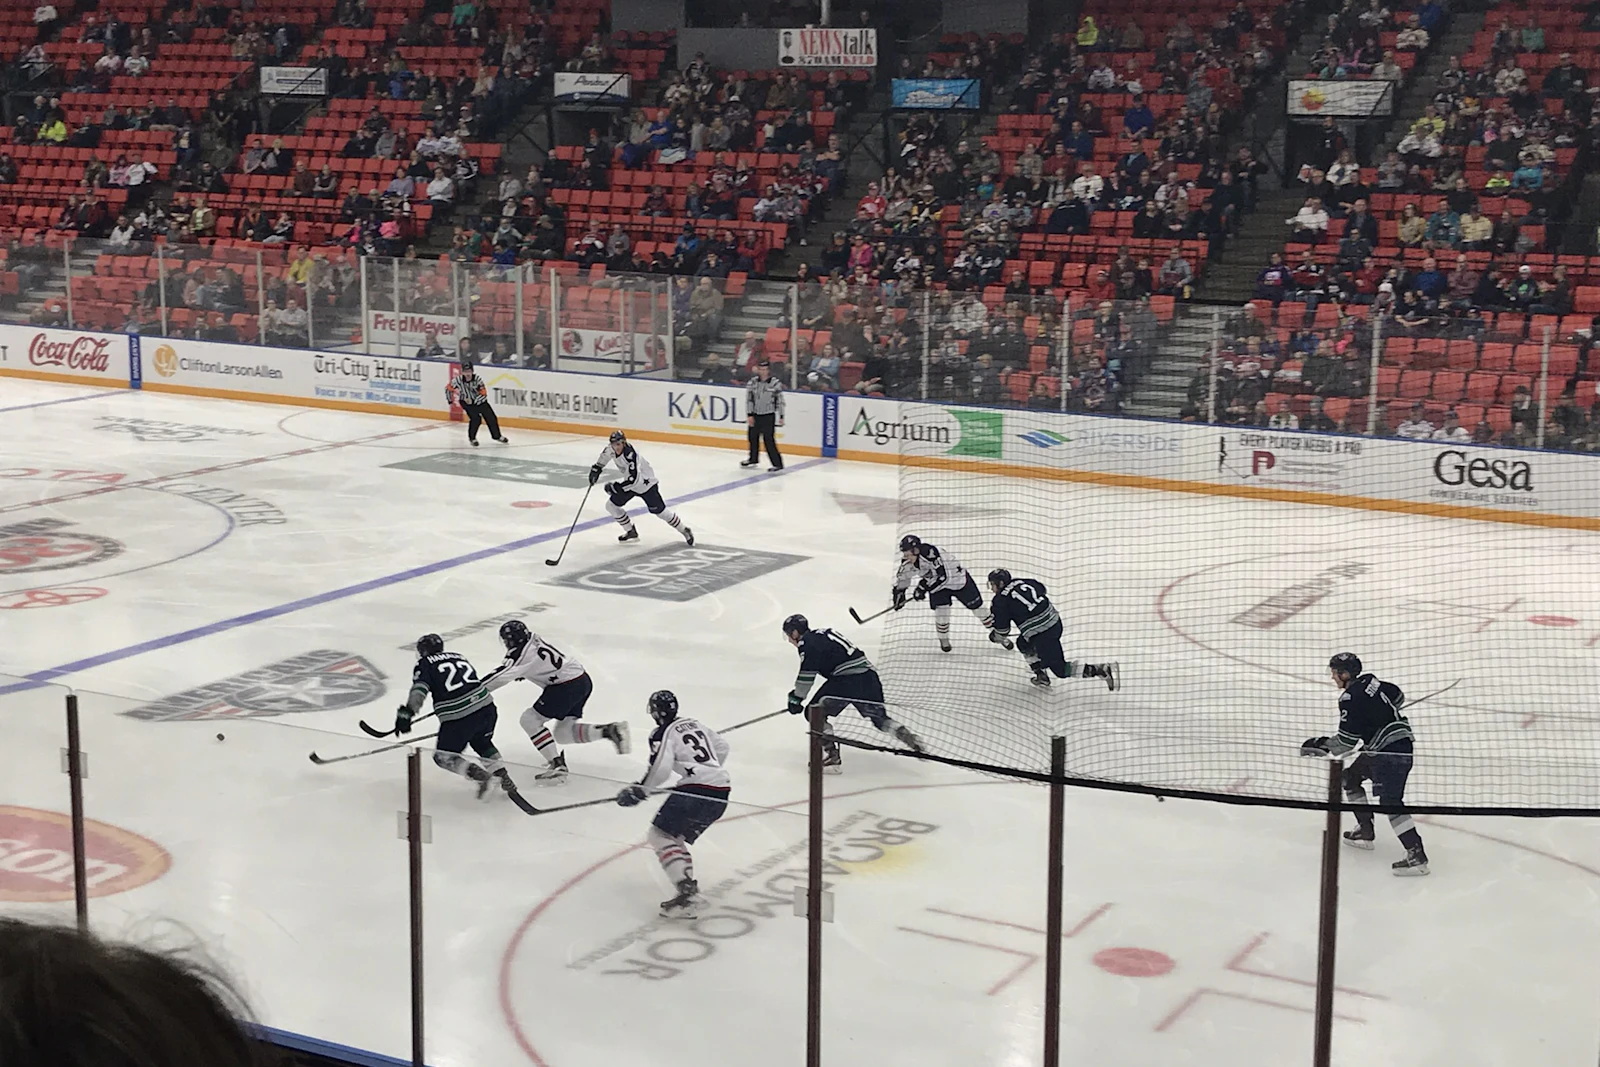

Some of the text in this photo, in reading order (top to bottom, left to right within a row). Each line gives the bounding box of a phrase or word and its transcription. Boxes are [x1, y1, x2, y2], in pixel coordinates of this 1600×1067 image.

[409, 316, 455, 336] Meyer
[29, 333, 113, 372] Coca-Cola
[180, 358, 283, 379] CliftonLarsonAllen
[314, 354, 421, 382] Tri-City Herald
[493, 387, 528, 407] THINK
[530, 391, 570, 411] RANCH
[583, 395, 618, 415] HOME
[849, 406, 951, 446] Agrium
[1434, 450, 1535, 492] Gesa
[577, 549, 745, 589] Gesa
[1011, 583, 1045, 612] 12
[438, 660, 481, 692] 22
